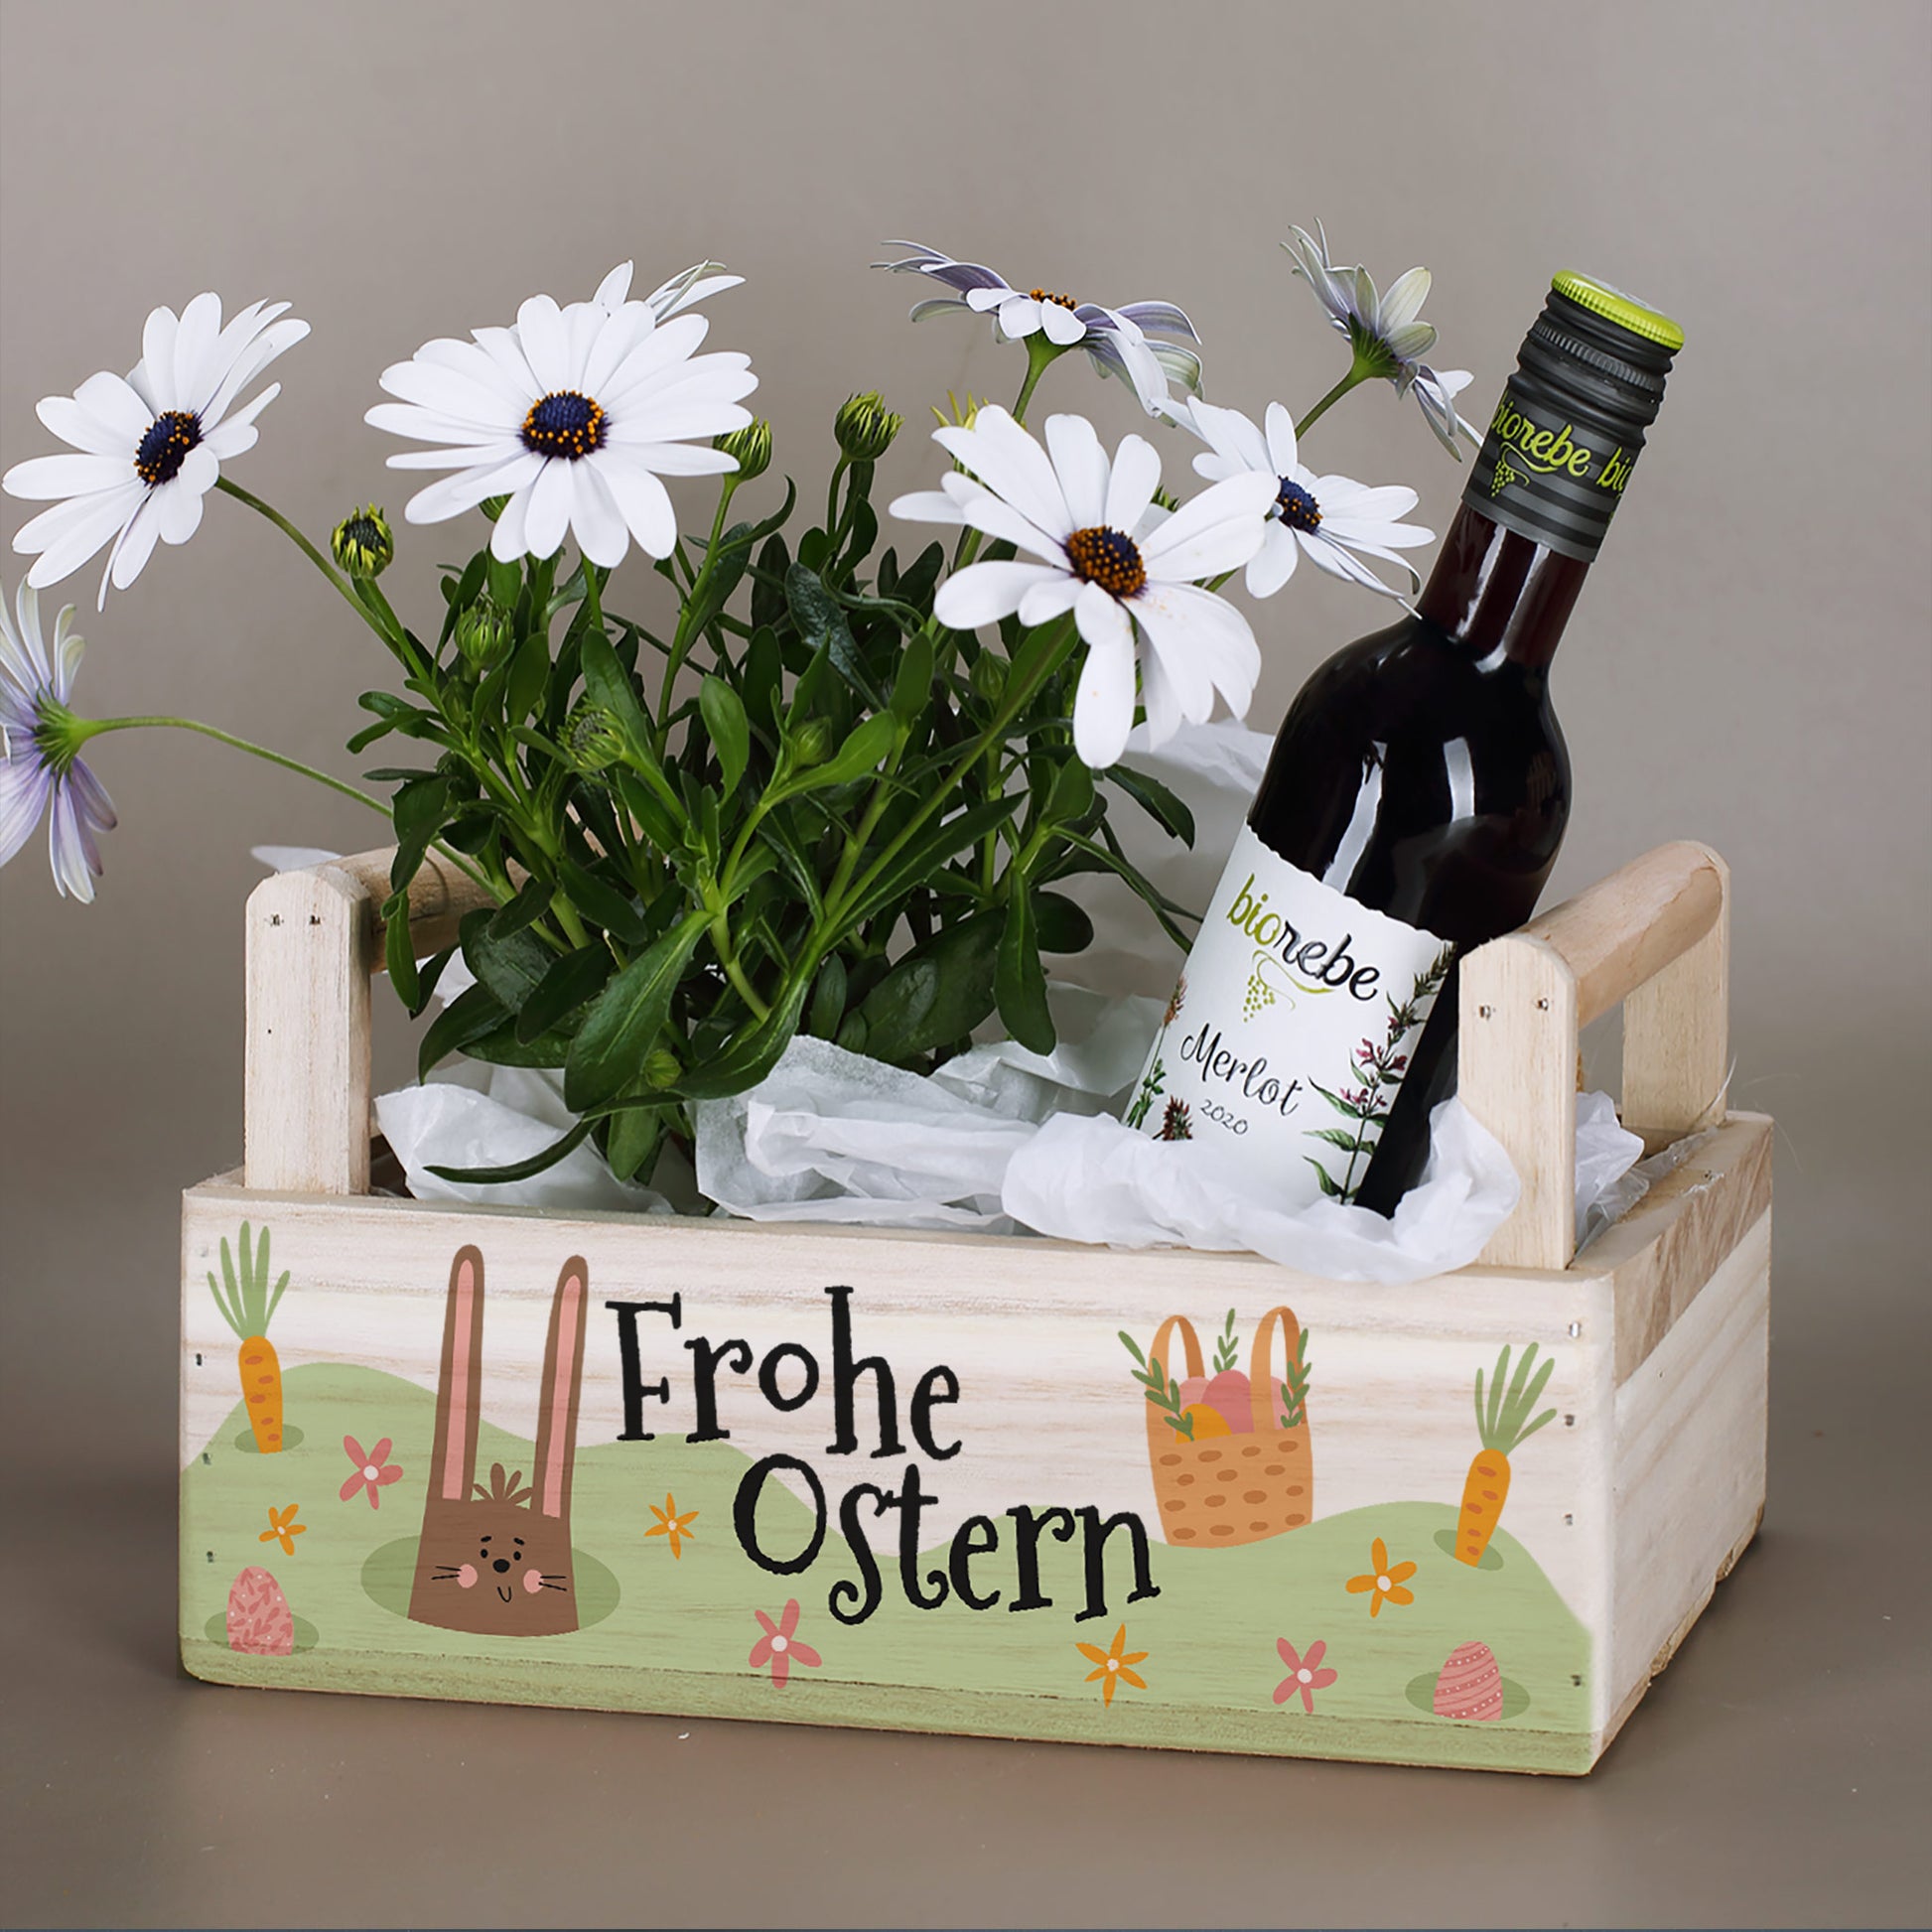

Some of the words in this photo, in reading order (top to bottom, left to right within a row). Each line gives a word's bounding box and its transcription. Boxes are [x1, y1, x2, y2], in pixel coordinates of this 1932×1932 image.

[1227, 874, 1381, 1001] biorebe
[1179, 1024, 1304, 1116] Merlot
[1200, 1099, 1248, 1136] 2020
[605, 1286, 962, 1459] Frohe
[733, 1453, 1161, 1625] Ostern
